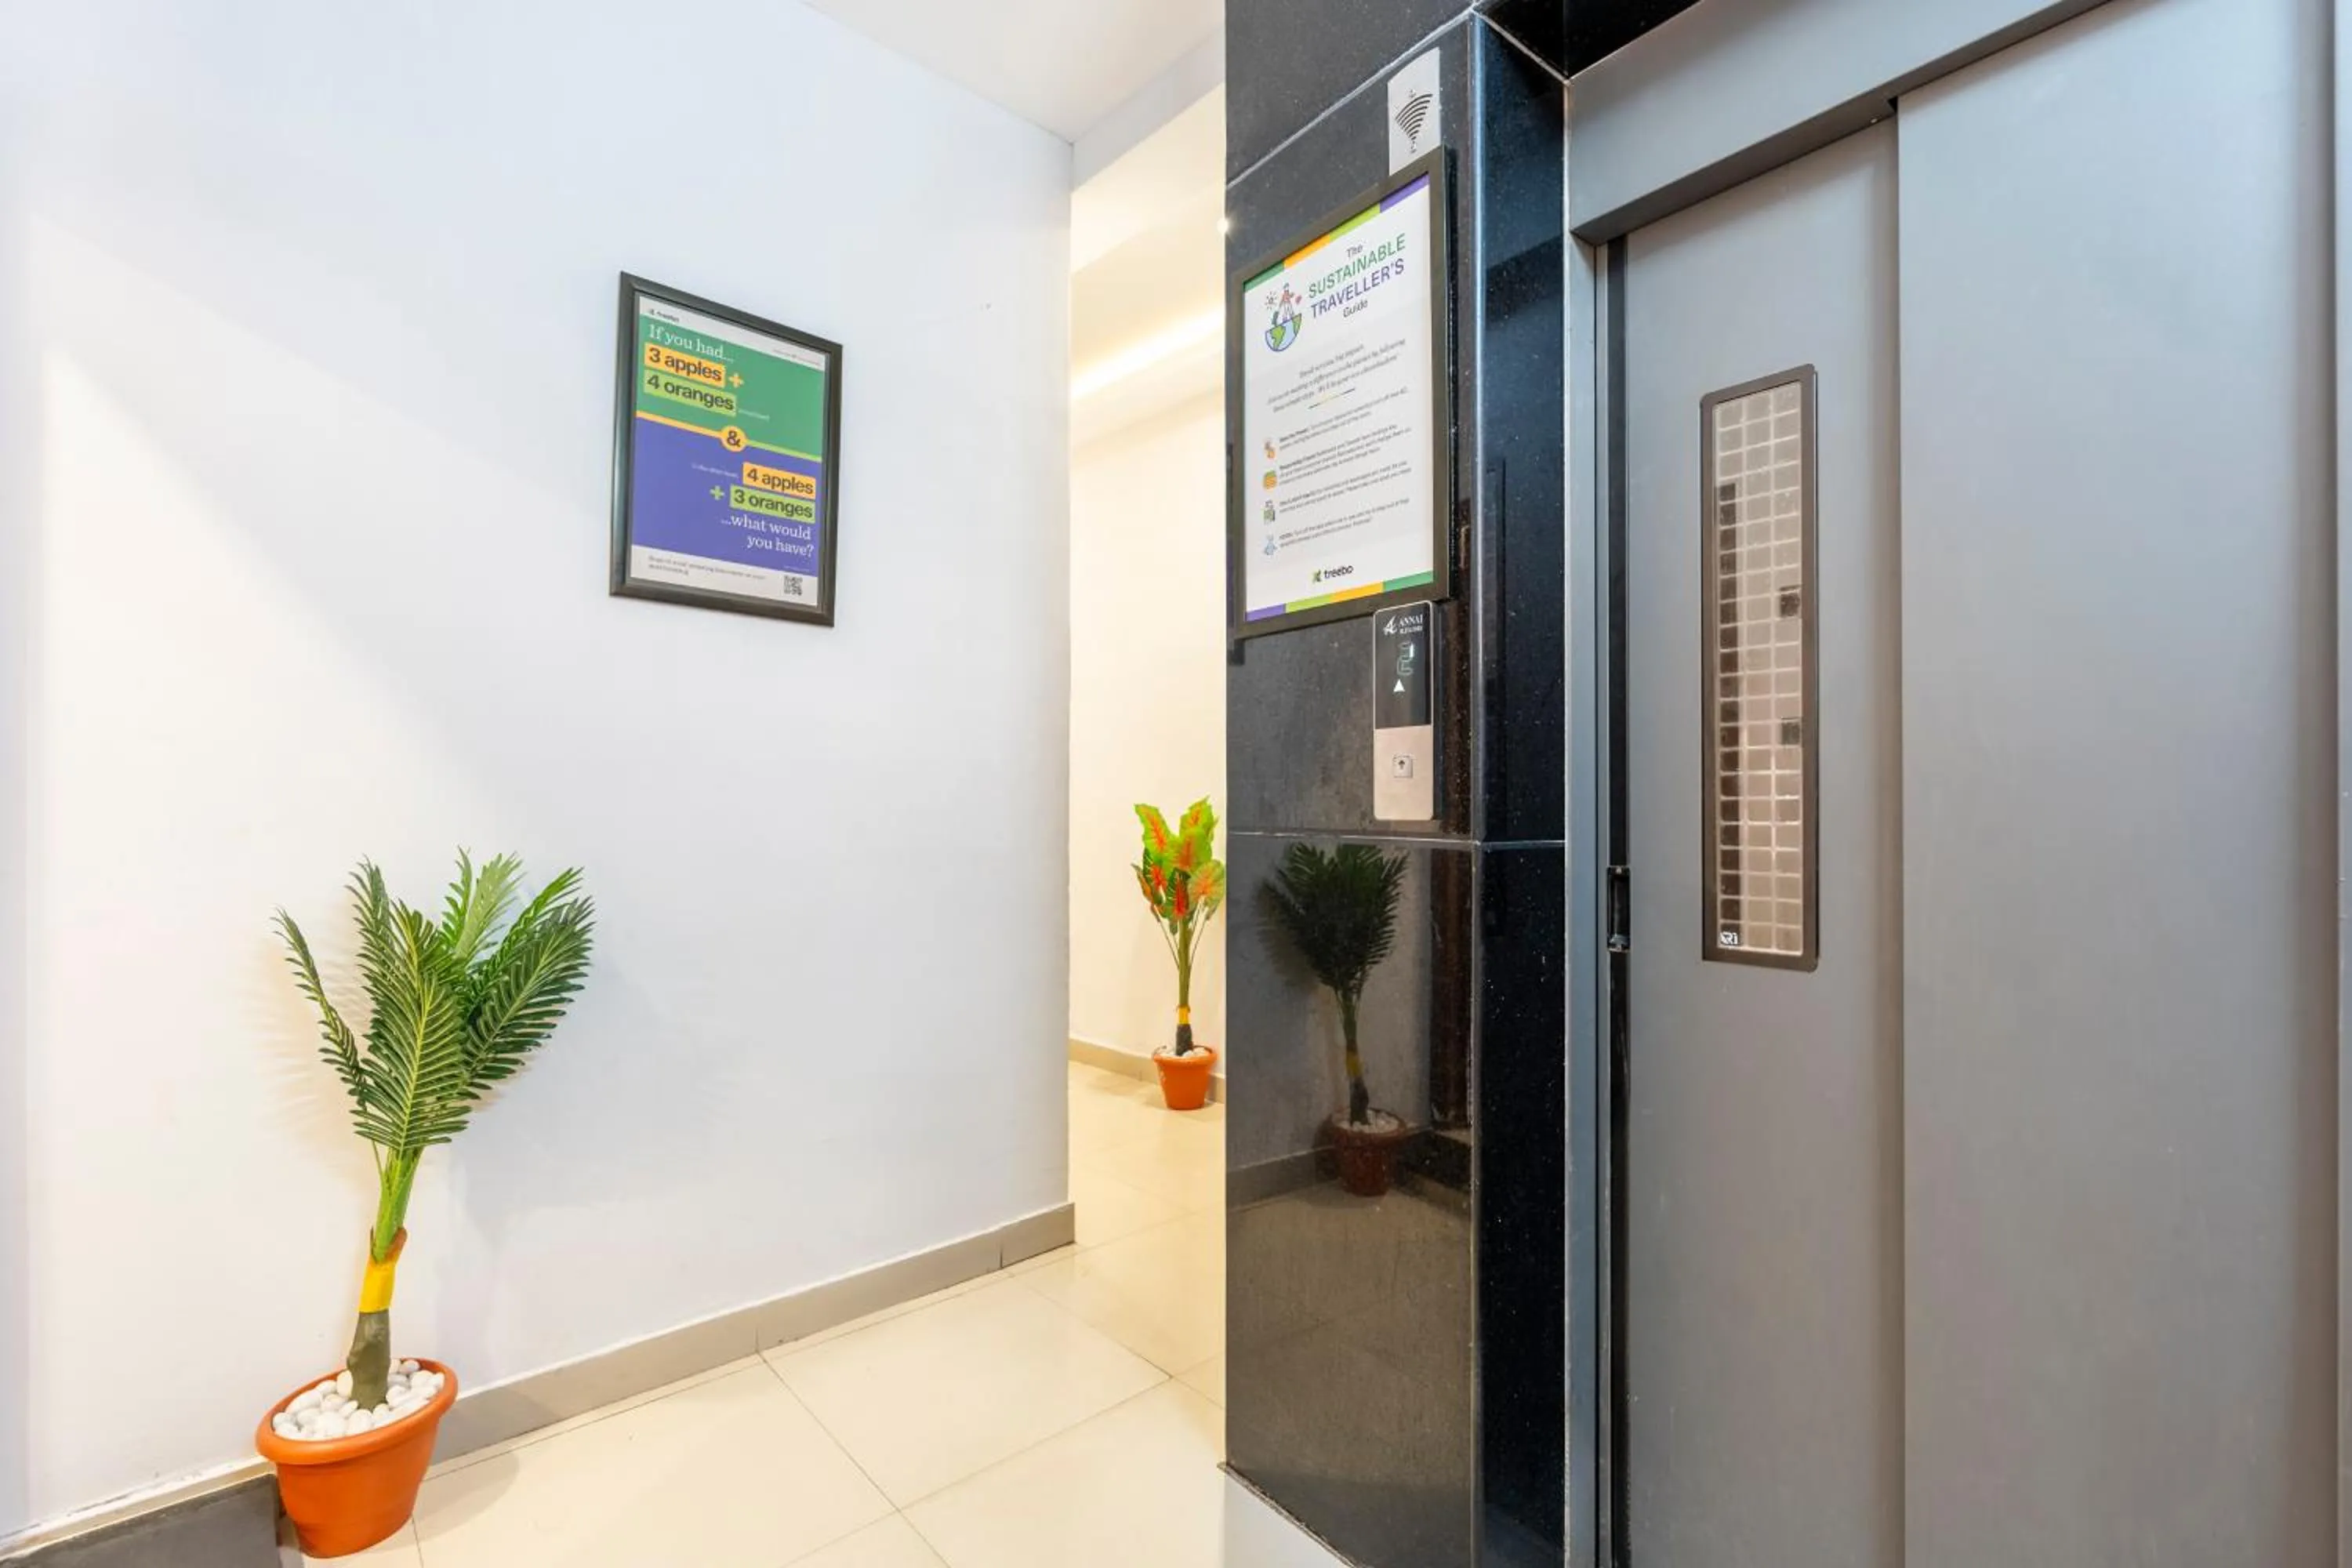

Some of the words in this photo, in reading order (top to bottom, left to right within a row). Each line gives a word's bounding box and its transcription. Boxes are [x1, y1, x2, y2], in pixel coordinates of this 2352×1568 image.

[1346, 245, 1363, 258] The
[1308, 233, 1406, 299] SUSTAINABLE
[1310, 258, 1404, 318] TRAVELLER'S
[1343, 299, 1368, 318] Guide
[649, 324, 665, 342] If
[664, 332, 692, 350] you
[649, 347, 661, 364] 3
[664, 355, 722, 382] apples
[647, 374, 660, 390] 4
[664, 382, 734, 410] oranges
[727, 430, 741, 448] &
[746, 468, 759, 482] 4
[762, 474, 814, 495] apples
[734, 488, 745, 504] 3
[749, 495, 813, 518] oranges
[770, 524, 811, 540] would
[747, 535, 772, 549] you
[775, 537, 815, 557] have?
[1323, 565, 1354, 579] treebo
